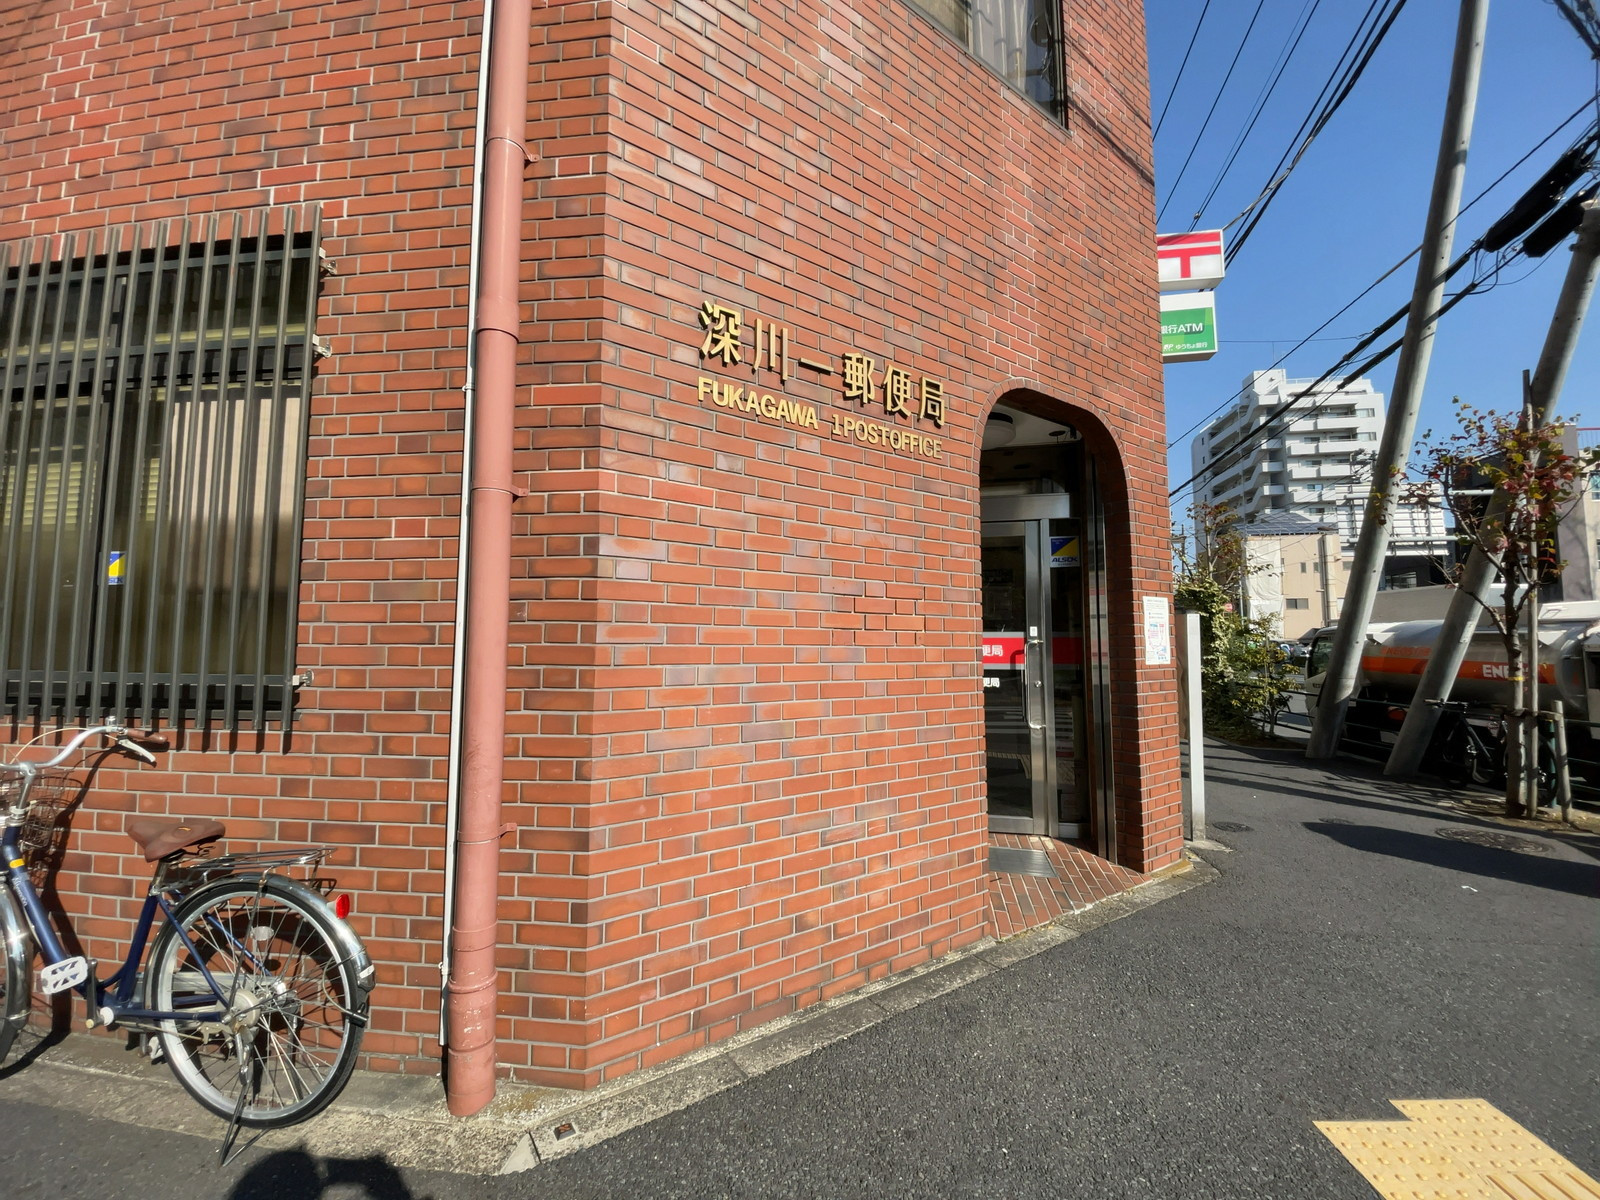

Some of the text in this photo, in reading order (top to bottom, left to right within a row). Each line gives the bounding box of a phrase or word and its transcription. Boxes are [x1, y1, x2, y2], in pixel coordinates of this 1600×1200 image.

[698, 300, 945, 427] 深川一郵便局
[698, 376, 818, 430] FUKAGAWA
